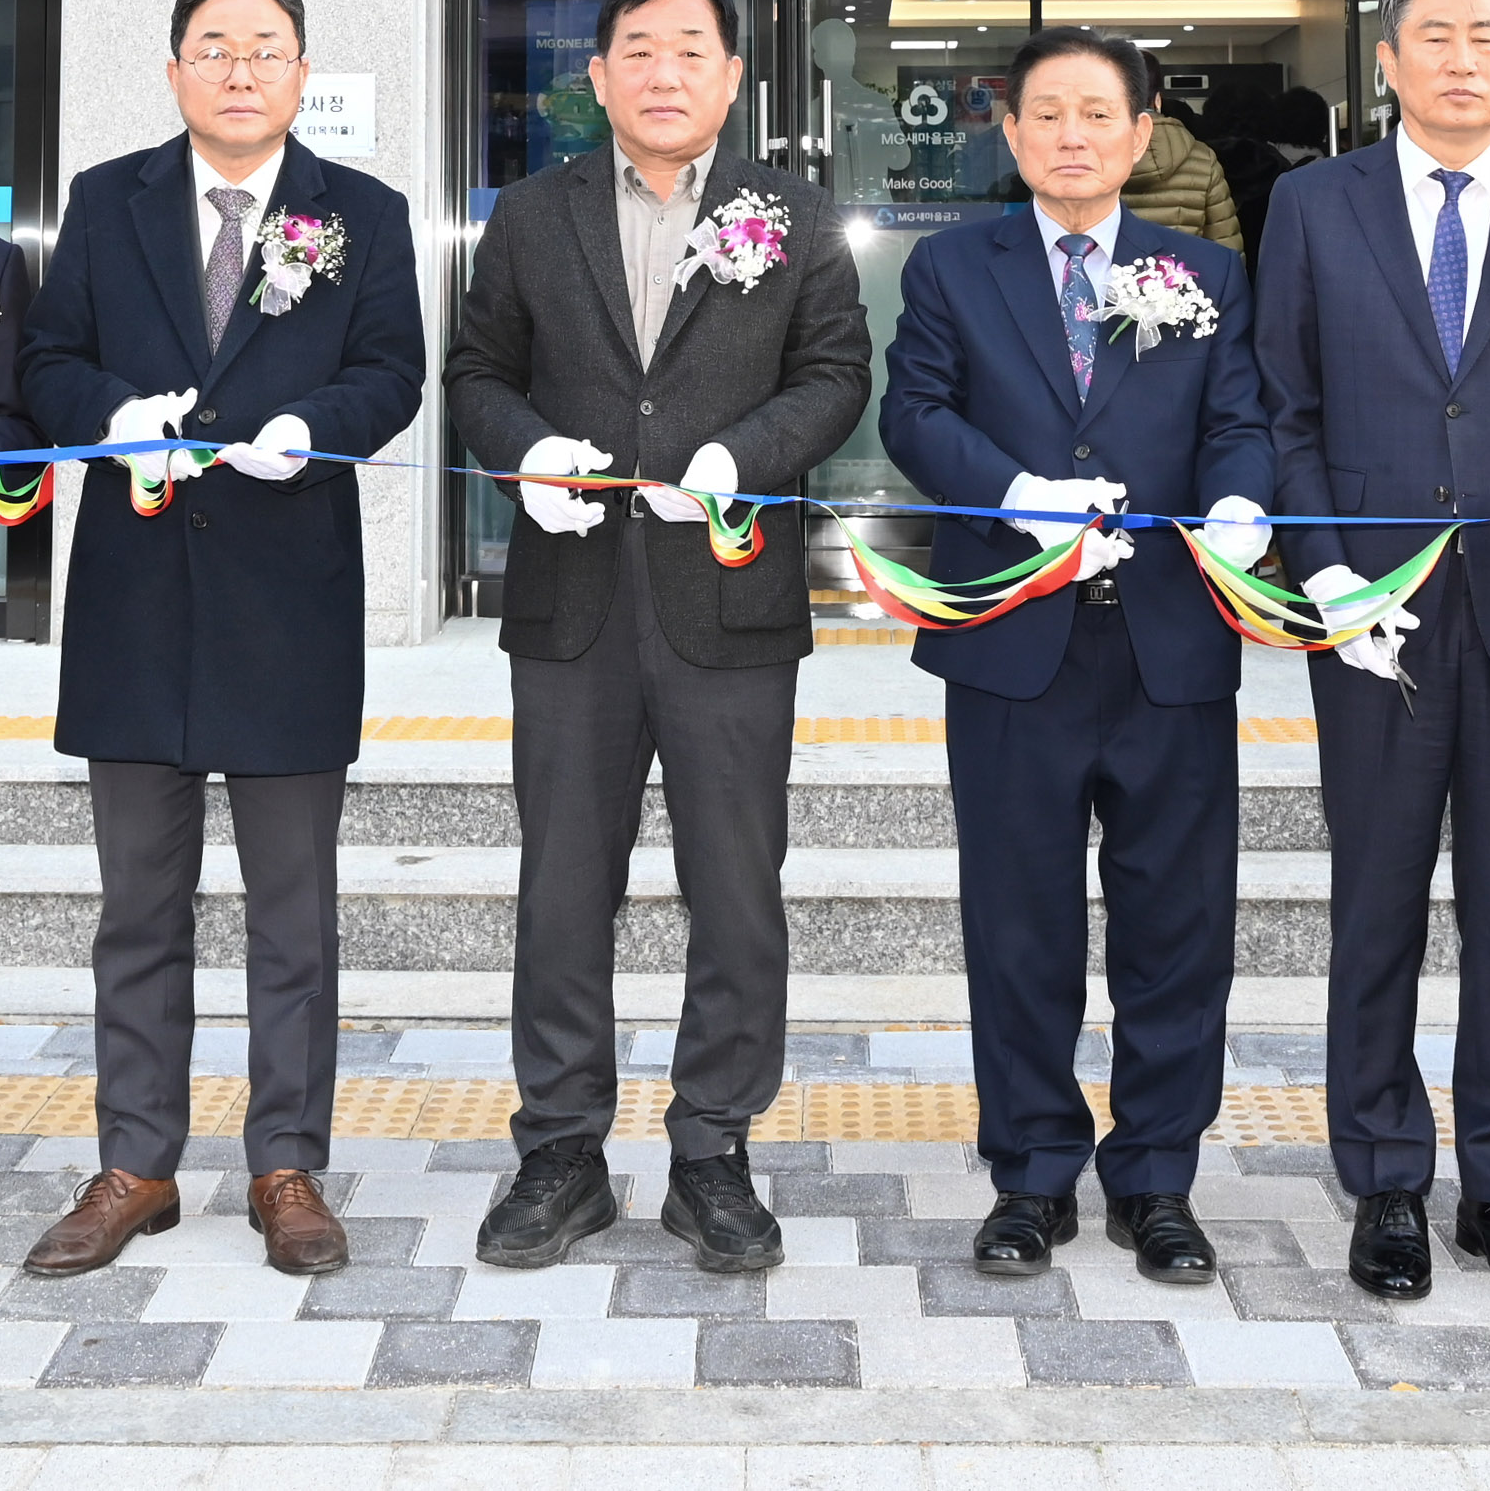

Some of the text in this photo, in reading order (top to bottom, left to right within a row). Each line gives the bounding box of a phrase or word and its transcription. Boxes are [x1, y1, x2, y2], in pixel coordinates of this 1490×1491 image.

[881, 132, 967, 145] MG새마을금고
[882, 177, 953, 190] Make Good
[898, 212, 961, 222] MG새마을금고
